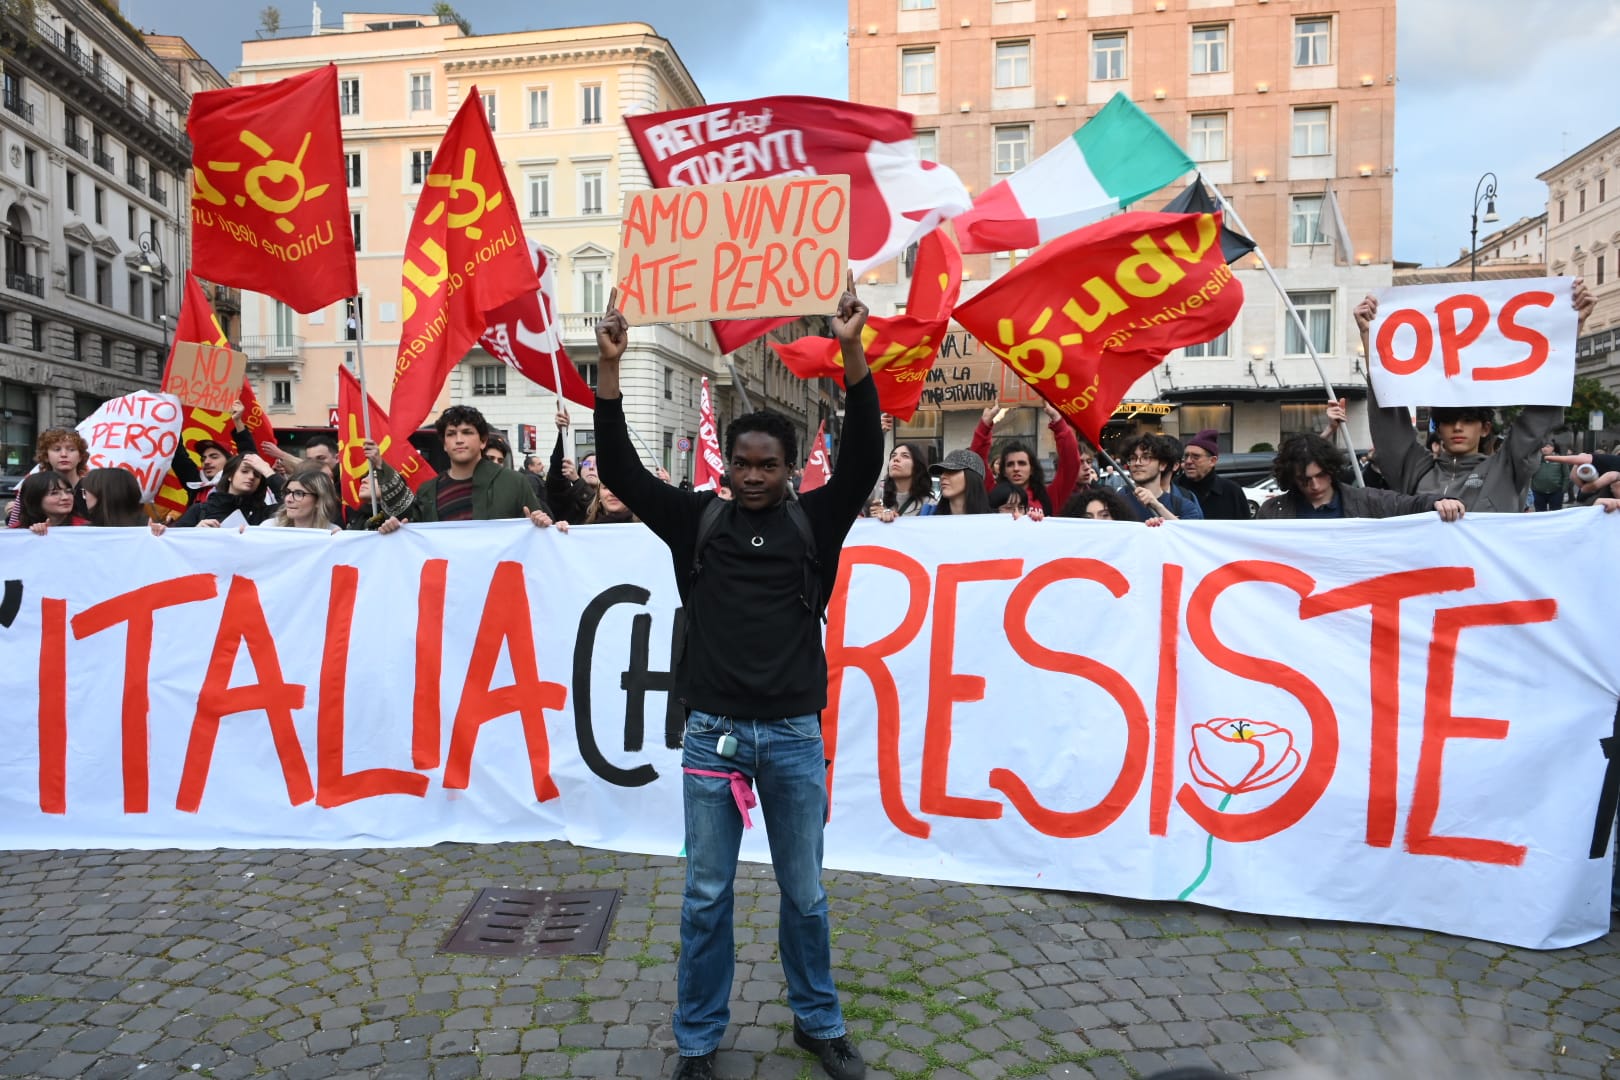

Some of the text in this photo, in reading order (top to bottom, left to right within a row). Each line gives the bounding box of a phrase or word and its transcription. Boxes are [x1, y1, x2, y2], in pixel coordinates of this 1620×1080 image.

[643, 107, 732, 162] RETE
[623, 179, 846, 250] AMO VINTO
[617, 237, 841, 316] ATE PERSO
[191, 346, 233, 385] NO
[1376, 290, 1555, 382] OPS
[953, 366, 971, 381] LA
[91, 422, 178, 459] PERSO
[571, 583, 685, 787] CH
[820, 544, 1558, 867] RESISTE
